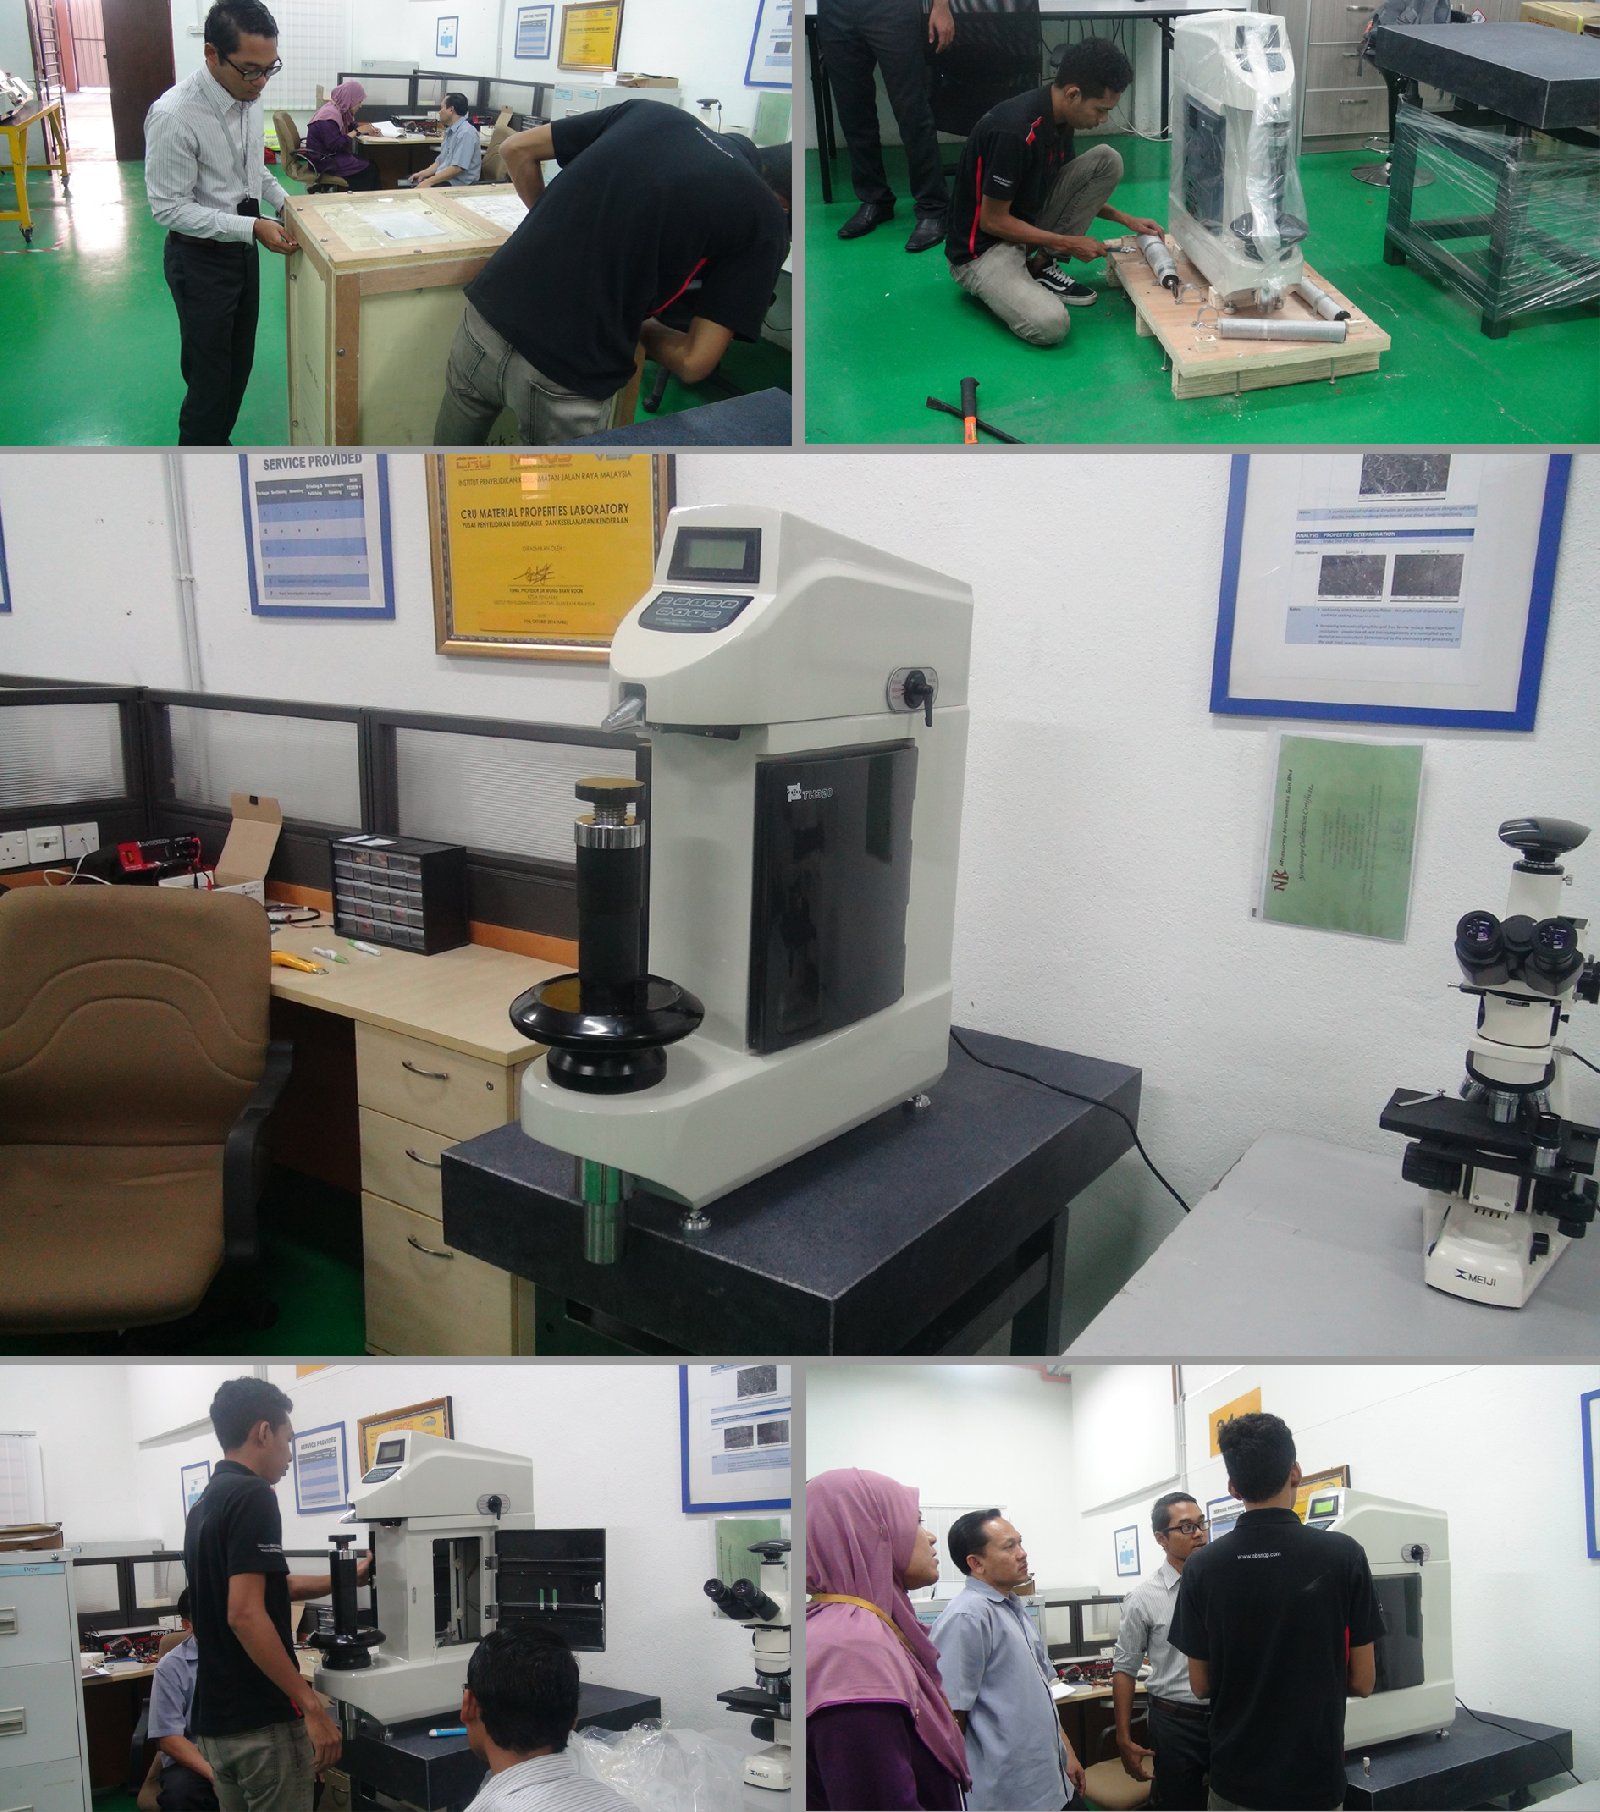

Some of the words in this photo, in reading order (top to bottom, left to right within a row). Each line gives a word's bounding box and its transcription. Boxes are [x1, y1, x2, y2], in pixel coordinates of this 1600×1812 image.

[264, 457, 305, 470] SERVICE
[308, 454, 362, 468] PROVIDED
[582, 472, 599, 480] RAYA
[600, 470, 632, 479] MALAYSIA
[461, 509, 477, 519] CRU
[480, 507, 518, 519] MATERIAL
[520, 505, 567, 518] PROPERTIES
[570, 503, 629, 516] LABORATORY
[1271, 869, 1289, 892] NK
[1468, 1273, 1496, 1287] MEIJI
